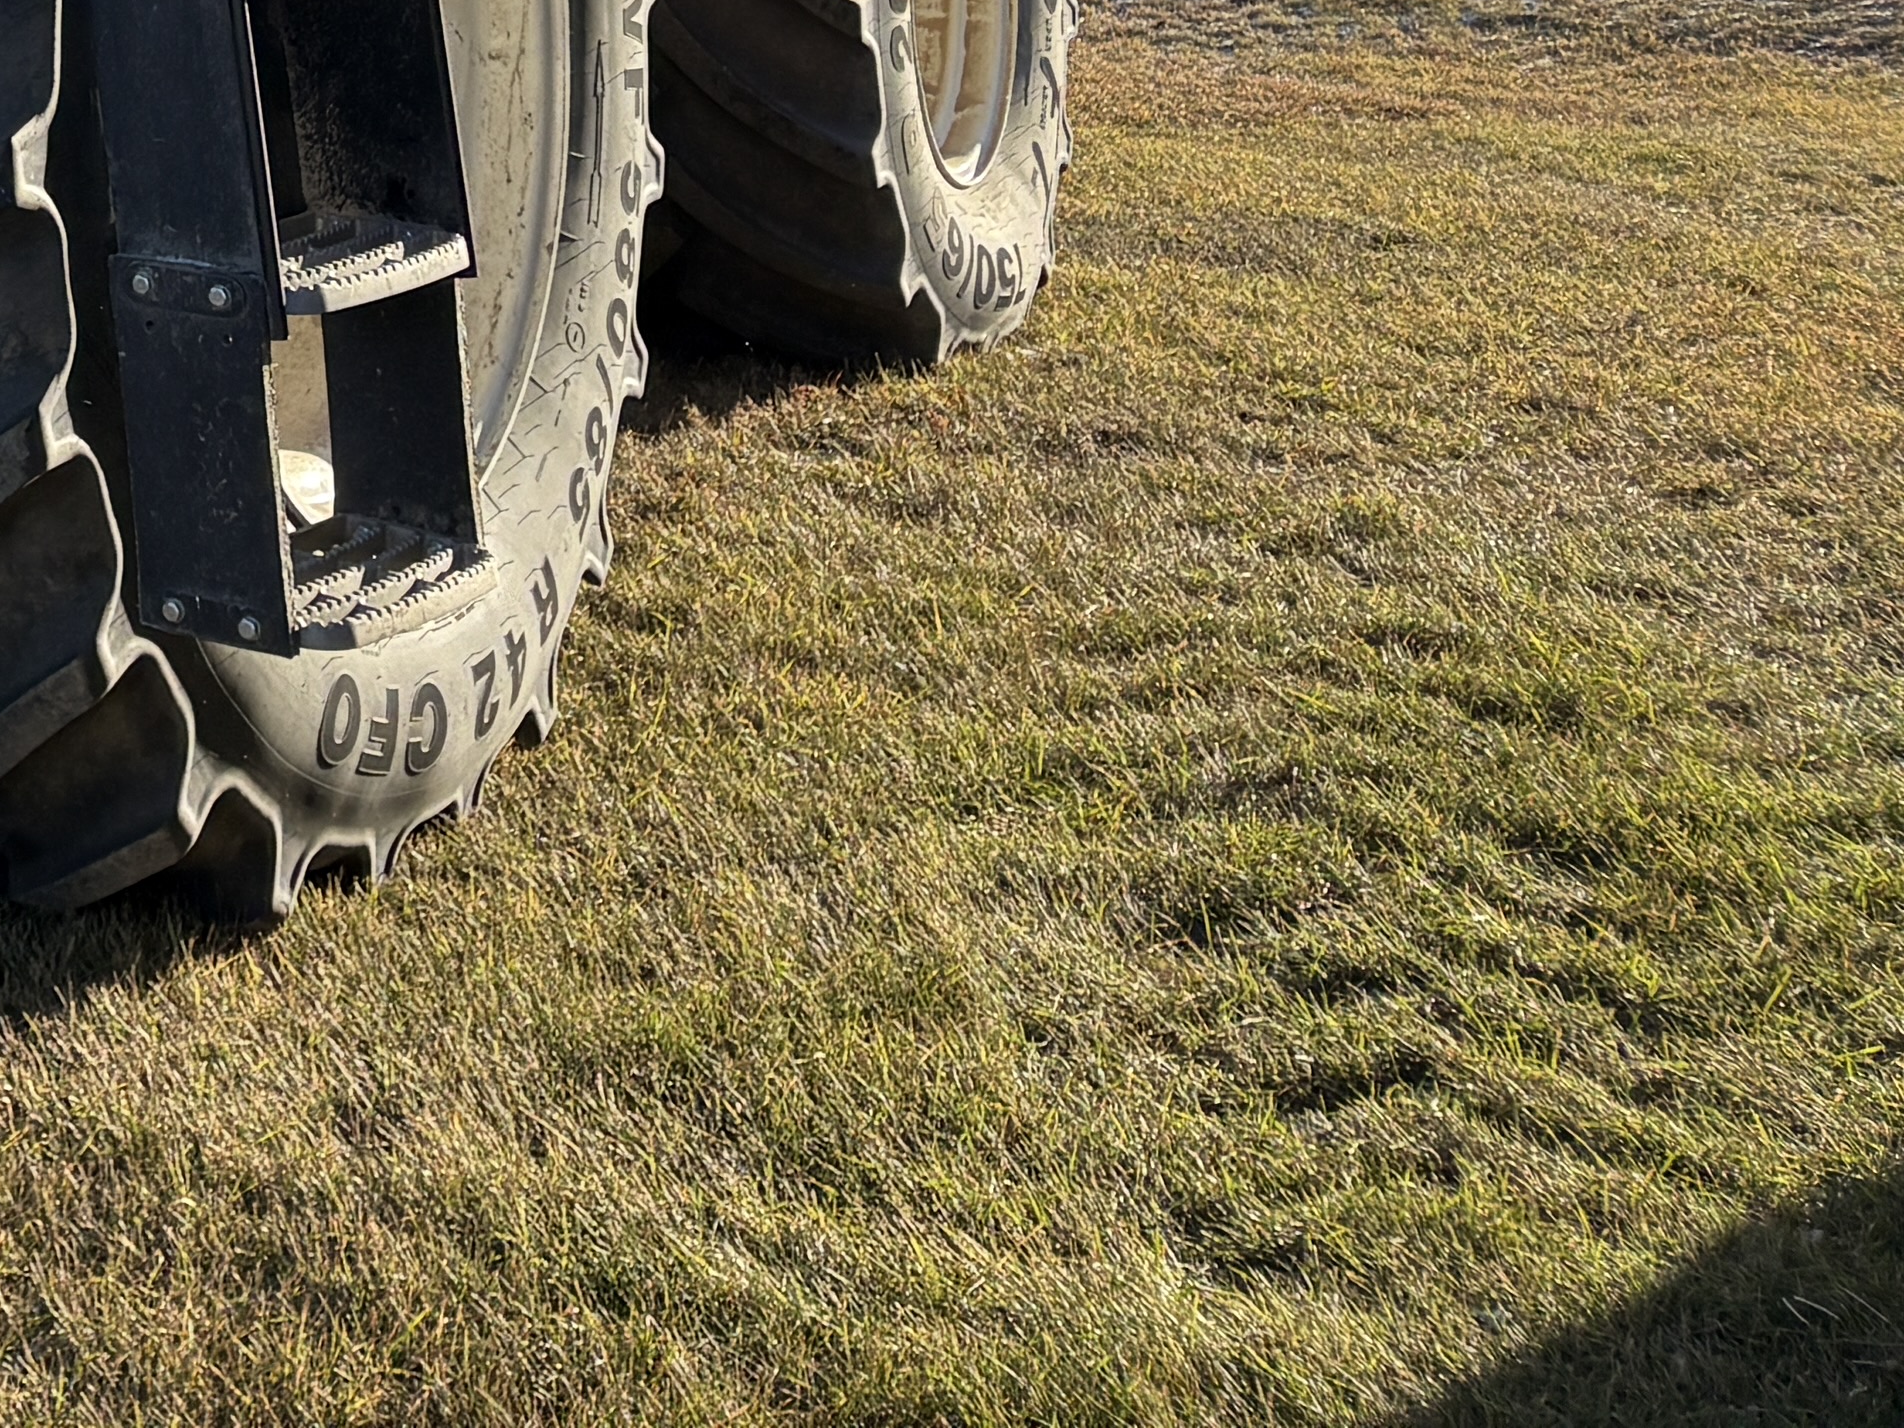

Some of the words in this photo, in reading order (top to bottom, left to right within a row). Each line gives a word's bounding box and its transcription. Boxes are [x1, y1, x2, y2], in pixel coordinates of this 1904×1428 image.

[567, 159, 643, 544] 580/85
[530, 555, 561, 648] R
[318, 672, 449, 778] CFO
[472, 629, 530, 744] 42
